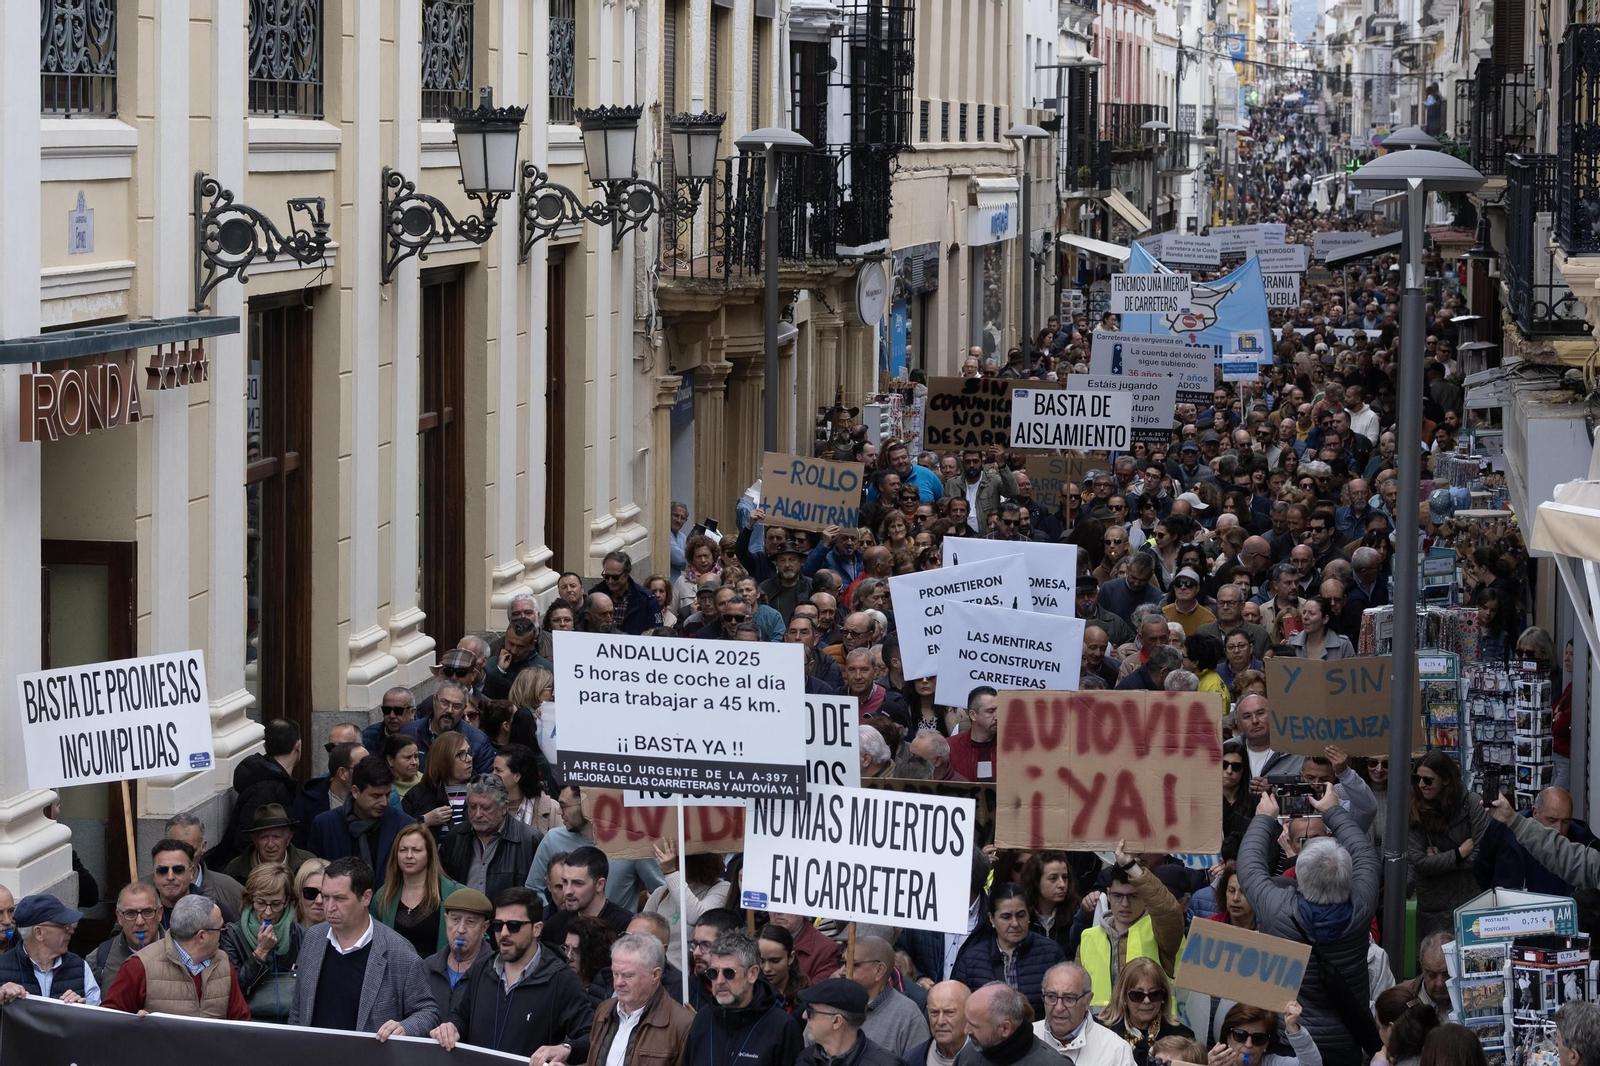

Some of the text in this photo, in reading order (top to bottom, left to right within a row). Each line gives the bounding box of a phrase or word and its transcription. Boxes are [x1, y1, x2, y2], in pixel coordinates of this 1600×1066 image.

[1113, 274, 1189, 292] TENEMOS UNA MIERDA
[1262, 273, 1294, 289] RRANÍA
[1124, 295, 1178, 313] DE CARRETERAS
[1096, 333, 1131, 342] Carreteras
[1130, 347, 1207, 360] La cuenta del olvido
[1138, 358, 1199, 369] sigue subiendo:
[961, 378, 1009, 397] SIN
[1087, 379, 1158, 391] Estáis jugando
[1177, 382, 1201, 390] ADOS
[1185, 374, 1208, 383] años
[20, 360, 143, 442] RONDA
[1034, 393, 1112, 418] BASTA DE
[1131, 403, 1154, 413] uturo
[1143, 395, 1160, 403] pan
[952, 410, 985, 428] NO
[1137, 414, 1160, 424] hijos
[927, 425, 1010, 449] DESARR
[1014, 422, 1126, 448] AISLAMIENTO
[1049, 459, 1084, 476] SIN
[918, 574, 1003, 600] PROMETIERON
[1028, 577, 1070, 592] OMESA,
[1032, 593, 1059, 609] OVÍA
[967, 630, 1053, 653] LAS MENTIRAS
[596, 642, 761, 667] ANDALUCÍA 2025
[958, 648, 1061, 673] NO CONSTRUYEN
[573, 664, 787, 691] 5 horas de coche al día
[969, 669, 1047, 690] CARRETERAS
[1281, 664, 1386, 696] Y SIN
[23, 657, 201, 725] BASTA DE PROMESAS
[578, 690, 782, 713] para trabajar a 45 km.
[822, 702, 853, 748] DE
[59, 721, 180, 779] INCUMPLIDAS
[634, 735, 698, 754] BASTA
[701, 739, 727, 757] YA
[732, 741, 744, 757] !!
[573, 761, 633, 775] ARREGLO
[639, 765, 700, 780] URGENTE
[705, 769, 723, 781] DE
[729, 770, 746, 782] LA
[751, 772, 789, 783] A-397
[569, 772, 612, 786] MEJORA
[612, 775, 629, 787] DE
[628, 776, 649, 789] LAS
[650, 777, 722, 794] CARRETERAS
[722, 783, 731, 794] Y
[730, 782, 778, 795] AUTOVÍA
[778, 785, 793, 796] YA
[753, 793, 786, 838] NO
[791, 791, 845, 845] MAS
[849, 796, 967, 857] MUERTOS
[770, 853, 939, 922] EN CARRETERA
[1521, 918, 1539, 927] 0,75
[1541, 917, 1548, 925] €
[1182, 933, 1306, 991] AUTOVIA
